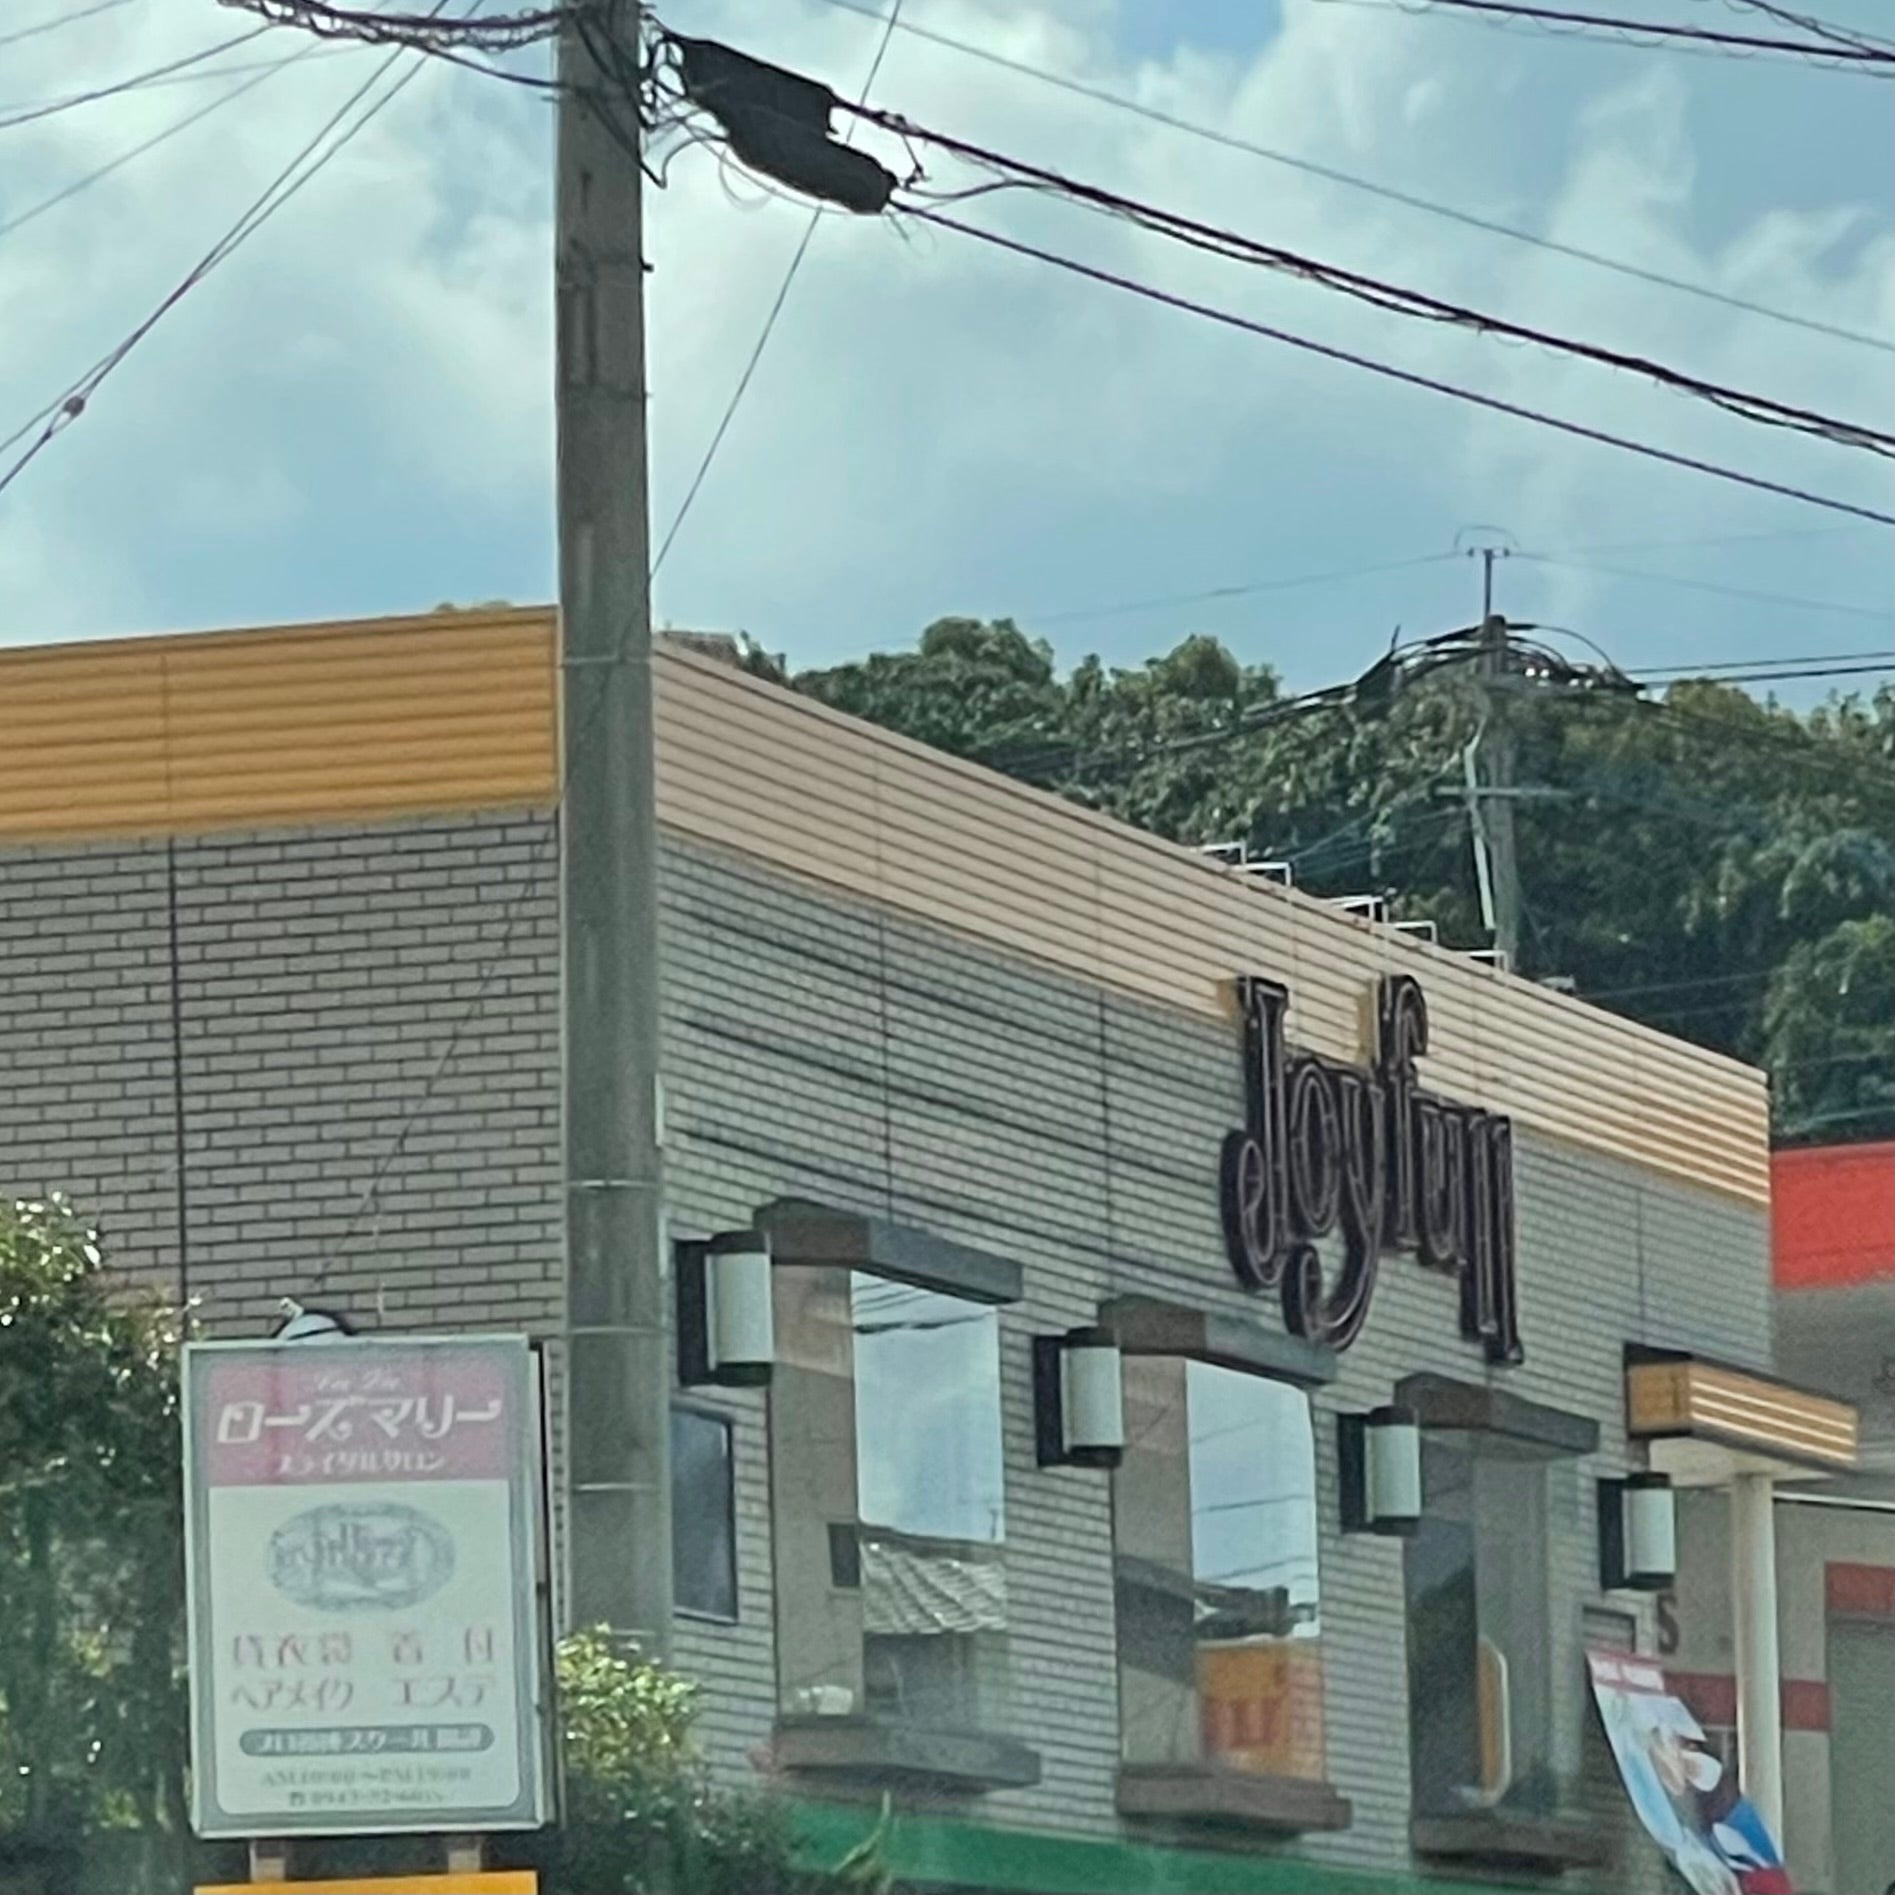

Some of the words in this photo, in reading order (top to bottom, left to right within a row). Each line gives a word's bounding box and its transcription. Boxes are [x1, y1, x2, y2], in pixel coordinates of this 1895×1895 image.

[217, 1394, 502, 1444] ローズマリー
[391, 1674, 498, 1709] エステ
